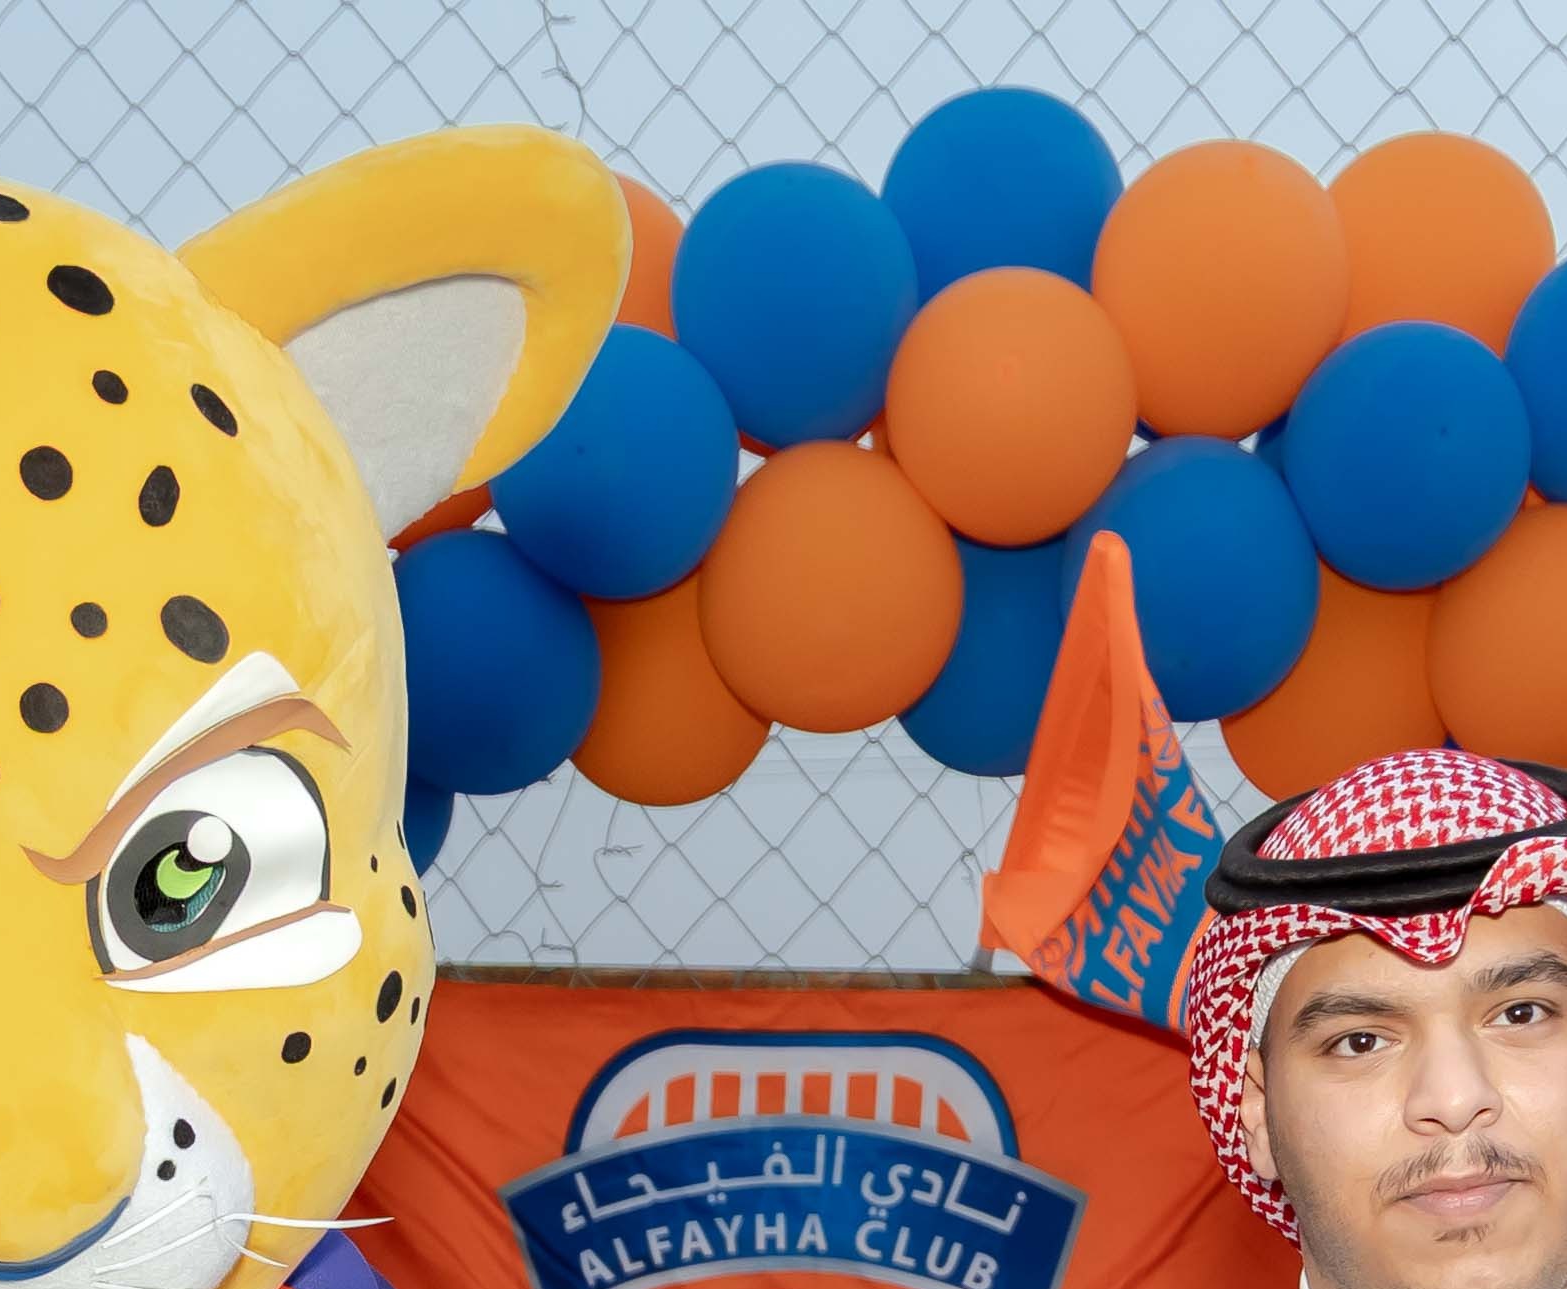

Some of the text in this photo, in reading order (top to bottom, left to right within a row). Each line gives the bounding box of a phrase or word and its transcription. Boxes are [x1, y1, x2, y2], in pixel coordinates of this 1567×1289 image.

[560, 1133, 1028, 1234] نادي الفيحاء
[577, 1212, 829, 1288] ALFAYHA
